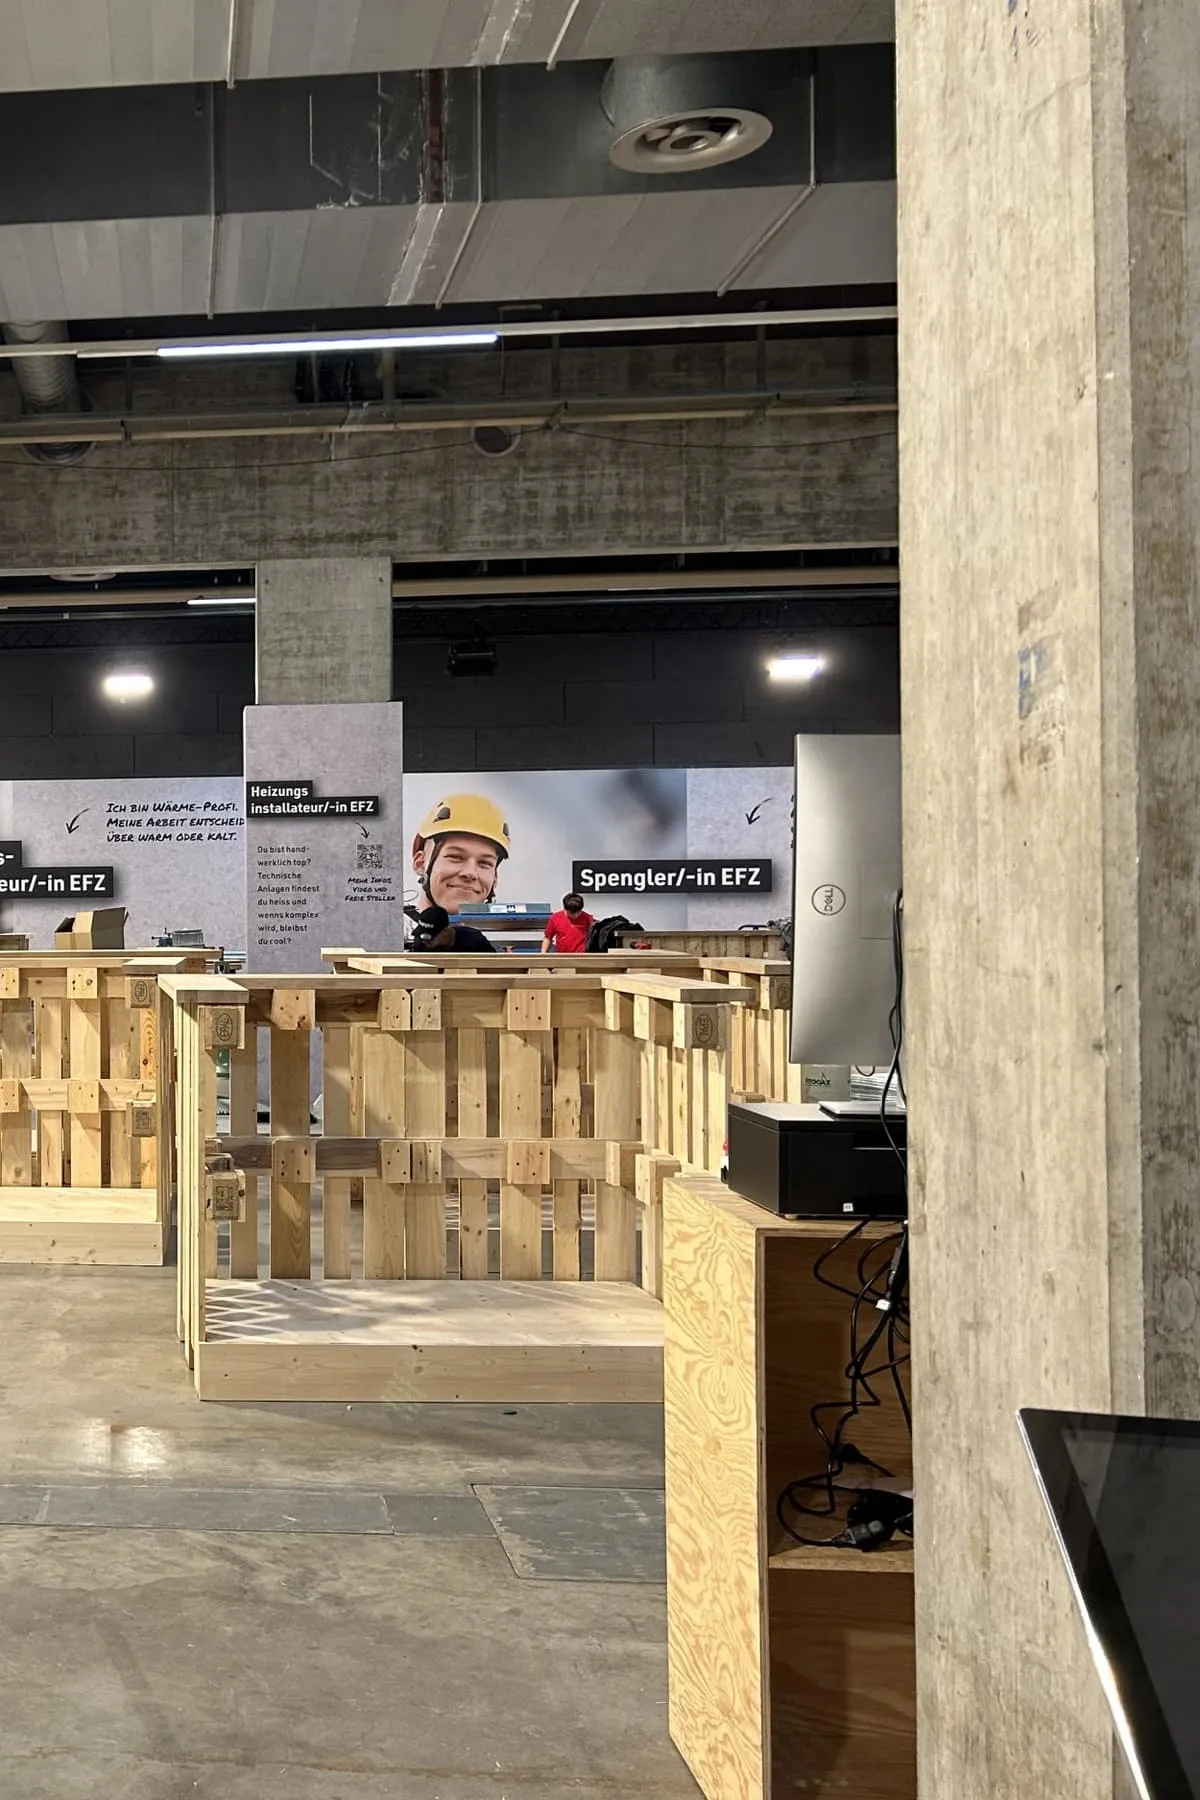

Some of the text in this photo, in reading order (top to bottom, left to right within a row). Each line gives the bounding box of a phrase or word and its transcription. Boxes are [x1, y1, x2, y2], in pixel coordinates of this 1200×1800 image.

[251, 786, 309, 799] Heizungs
[106, 800, 238, 813] ICH BIN WÄRME-PROFI.
[251, 801, 374, 814] installateur/-in EFZ
[106, 818, 143, 827] MEINE
[146, 817, 187, 827] ARBEIT
[107, 831, 237, 842] ÜBER WARM ODER KALT.
[286, 845, 310, 853] hand-
[293, 858, 312, 867] top?
[70, 874, 106, 891] EFZ
[580, 867, 761, 891] Spengler/-in EFZ
[257, 885, 290, 894] Anlagen
[285, 911, 320, 920] komplex
[280, 924, 308, 932] bleibst
[269, 937, 292, 945] cool?
